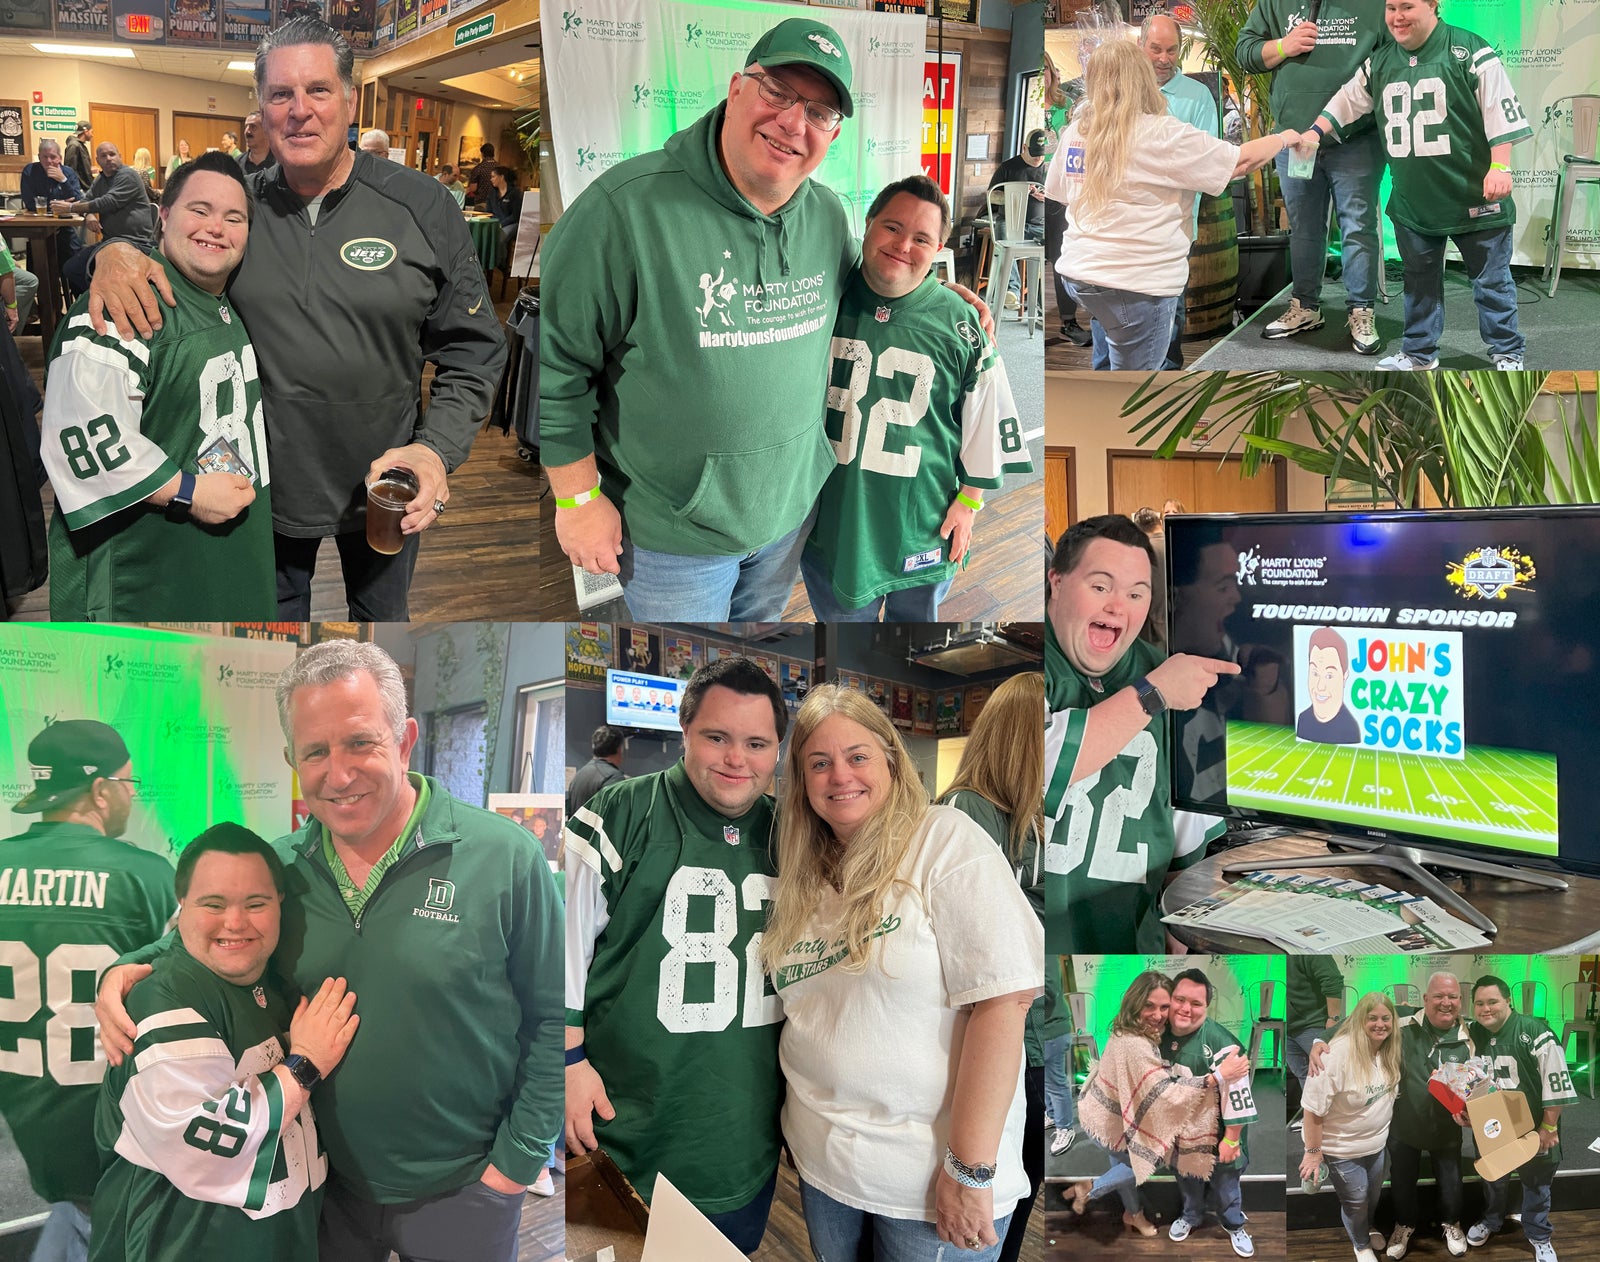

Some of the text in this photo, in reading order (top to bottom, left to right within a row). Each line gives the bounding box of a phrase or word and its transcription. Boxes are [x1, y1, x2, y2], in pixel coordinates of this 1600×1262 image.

[884, 4, 900, 14] PALE
[58, 11, 108, 26] MASSIVE
[129, 15, 150, 33] EXIT
[586, 19, 614, 28] MARTY
[169, 19, 217, 32] PUMPKIN
[224, 22, 248, 34] ROBERT
[376, 22, 394, 40] KISMET
[587, 26, 639, 38] FOUNDATION
[705, 30, 728, 38] MARTY
[706, 38, 747, 46] FOUNDATION
[1506, 56, 1557, 64] FOUNDATION
[654, 96, 699, 104] FOUNDATION
[46, 108, 76, 116] Bathrooms
[1382, 77, 1451, 158] 82
[350, 248, 386, 258] JETS
[742, 282, 788, 297] MARTY
[744, 290, 820, 313] FOUNDATION
[746, 316, 760, 325] The
[762, 314, 786, 324] courage
[787, 312, 795, 320] to
[795, 310, 807, 318] wish
[807, 306, 815, 315] for
[876, 312, 888, 320] NFL
[826, 336, 936, 478] 82
[60, 414, 132, 480] 82
[1261, 558, 1292, 567] MARTY
[1261, 569, 1318, 578] FOUNDATION
[1468, 571, 1510, 580] DRAFT
[1252, 604, 1517, 629] TOUCHDOWN SPONSOR
[197, 624, 212, 632] ALE
[266, 622, 300, 634] ORANGE
[247, 630, 268, 640] PALE
[1351, 638, 1452, 676] JOHN'S
[128, 669, 175, 678] FOUNDATION
[236, 670, 258, 678] MARTY
[568, 662, 592, 674] HOPSY
[236, 677, 276, 685] FOUNDATION
[613, 675, 631, 684] POWER
[1351, 677, 1449, 716] CRAZY
[1364, 714, 1461, 754] SOCKS
[2, 783, 32, 791] MARTY
[1362, 784, 1393, 796] 50
[726, 833, 738, 844] NFL
[0, 868, 110, 908] MARTIN
[424, 878, 456, 912] D
[413, 908, 460, 923] FOOTBALL
[786, 936, 828, 960] arty
[785, 958, 829, 984] ALL STARS
[0, 940, 121, 1086] 28
[1548, 1070, 1572, 1093] 82
[1229, 1088, 1254, 1112] 82
